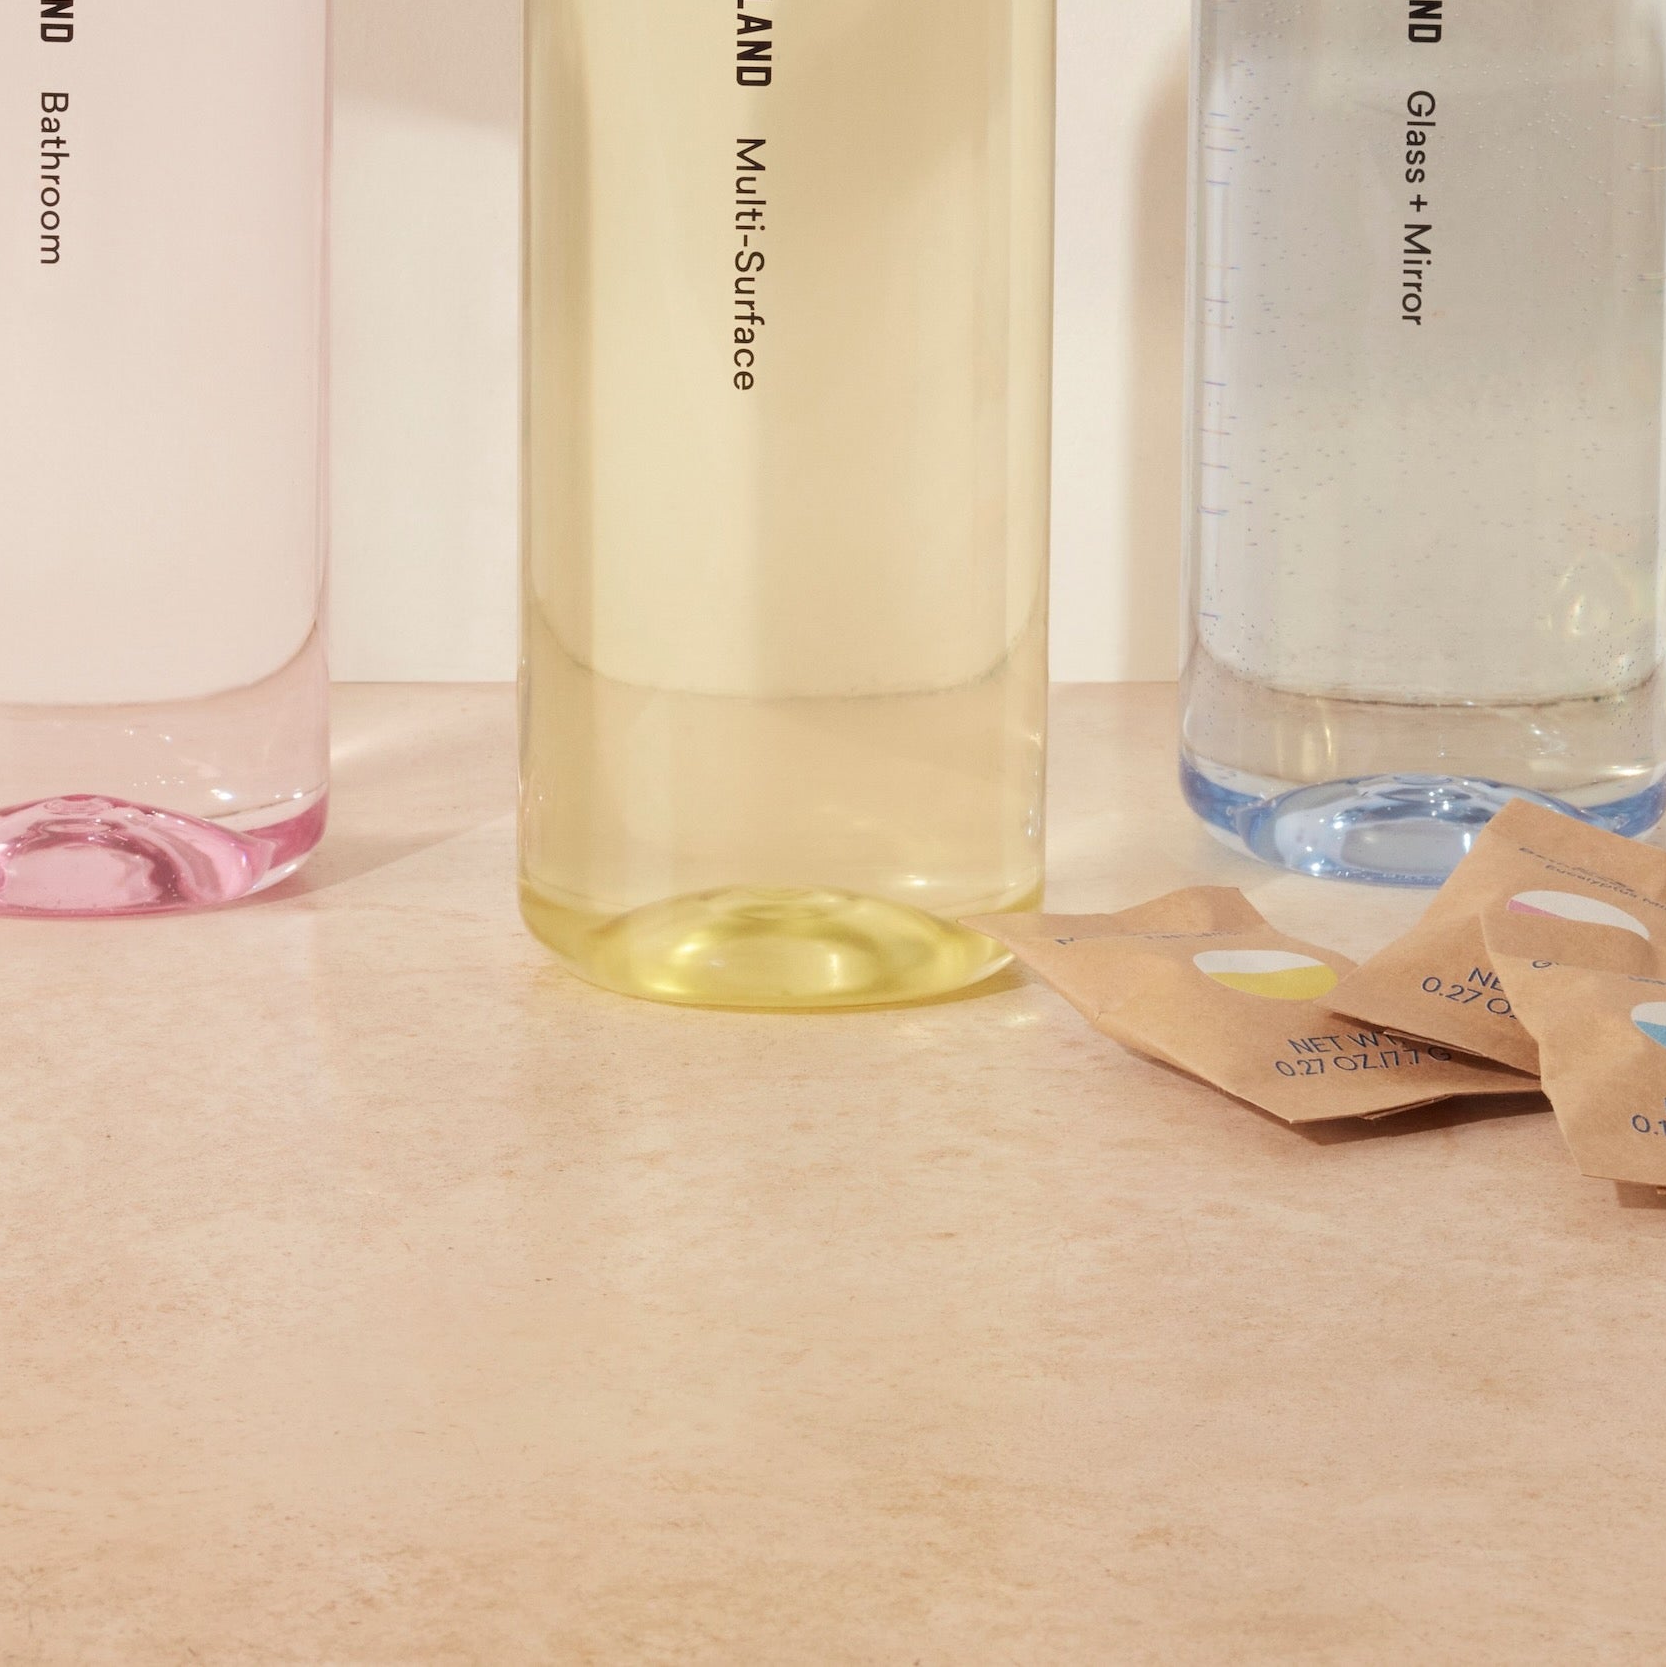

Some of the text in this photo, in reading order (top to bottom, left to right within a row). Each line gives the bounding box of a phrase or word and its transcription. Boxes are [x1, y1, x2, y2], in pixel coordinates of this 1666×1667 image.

[40, 92, 70, 264] Bathroom
[1405, 90, 1436, 184] Glass
[733, 138, 767, 392] Multi-Surface
[1402, 223, 1433, 326] Mirror
[1288, 1036, 1344, 1054] NET
[1421, 976, 1517, 1020] 0.27 O
[1275, 1058, 1325, 1077] 0.27
[1427, 1045, 1452, 1062] G
